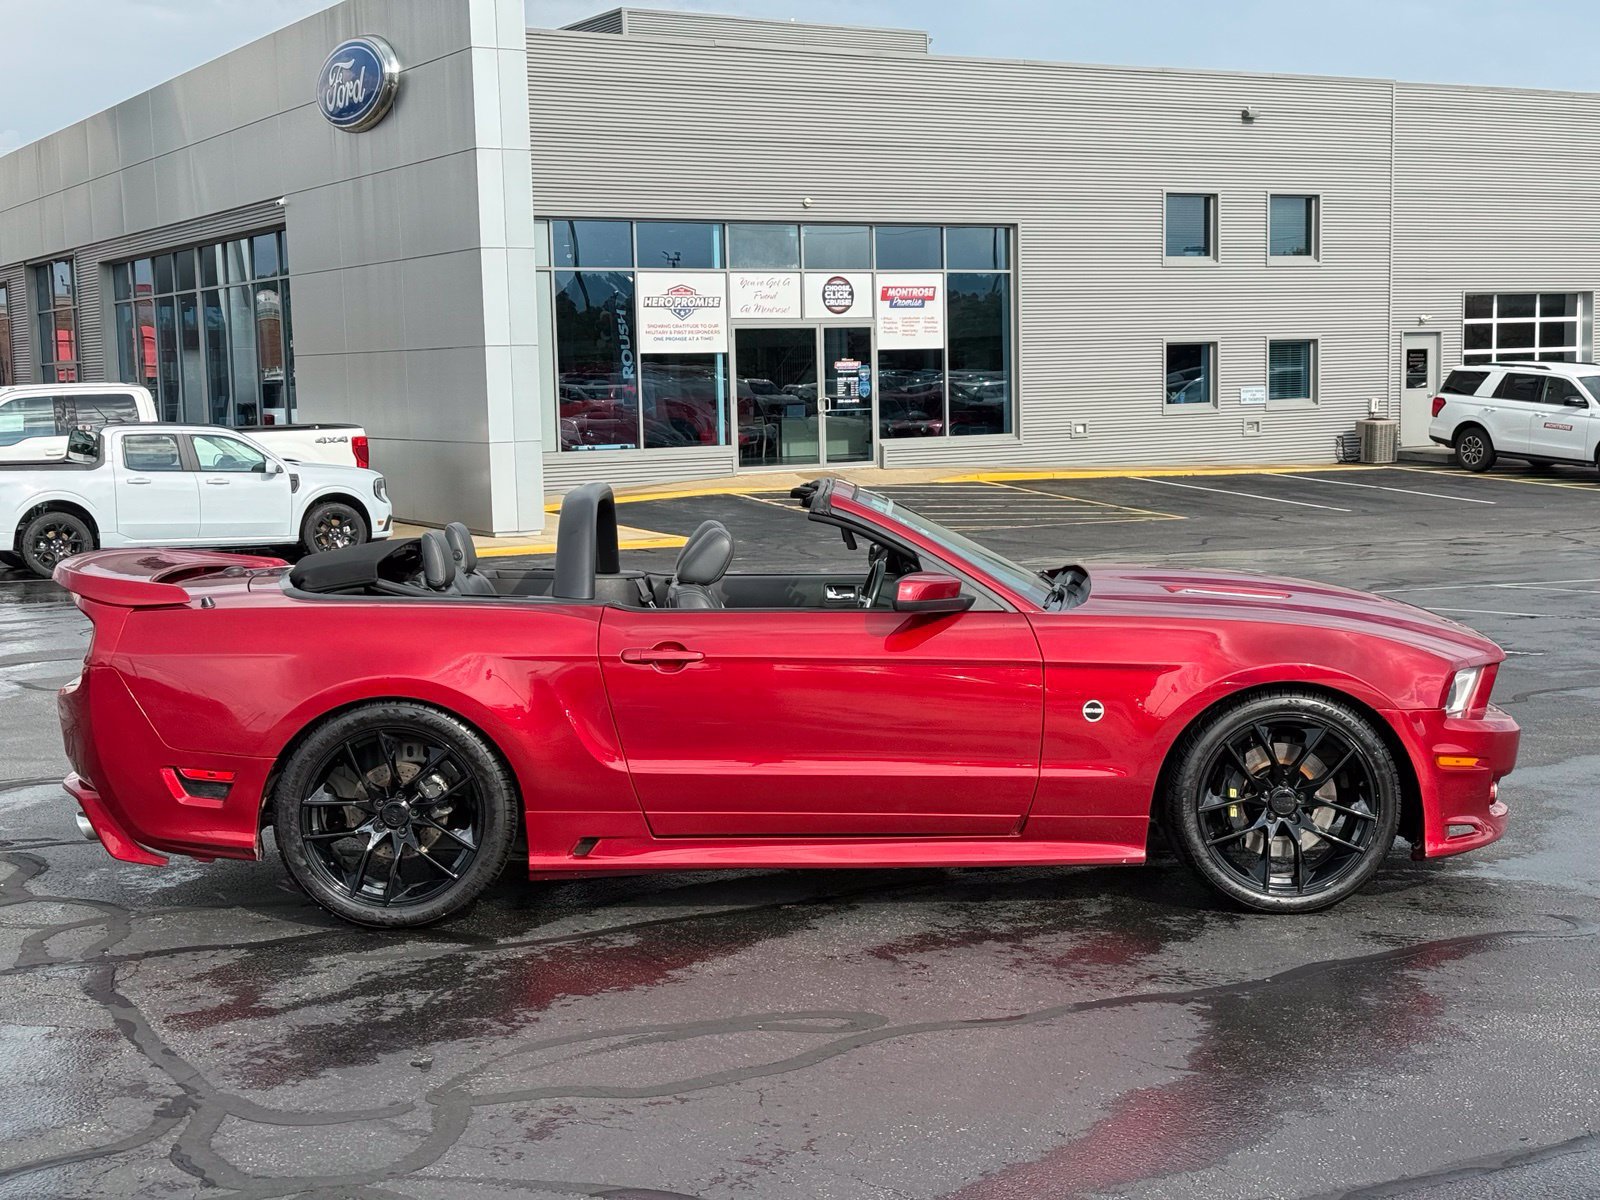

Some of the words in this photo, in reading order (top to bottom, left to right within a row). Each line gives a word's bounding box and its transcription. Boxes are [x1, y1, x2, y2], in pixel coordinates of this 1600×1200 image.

[326, 59, 365, 112] Ford
[740, 277, 765, 289] You've
[766, 277, 780, 288] Got
[753, 290, 778, 300] Friend
[825, 291, 852, 299] CLICK.
[887, 287, 935, 297] MONTROSE
[643, 296, 673, 308] HERO
[674, 296, 721, 308] PROMISE
[892, 297, 923, 307] Promise
[616, 308, 634, 379] ROUSH
